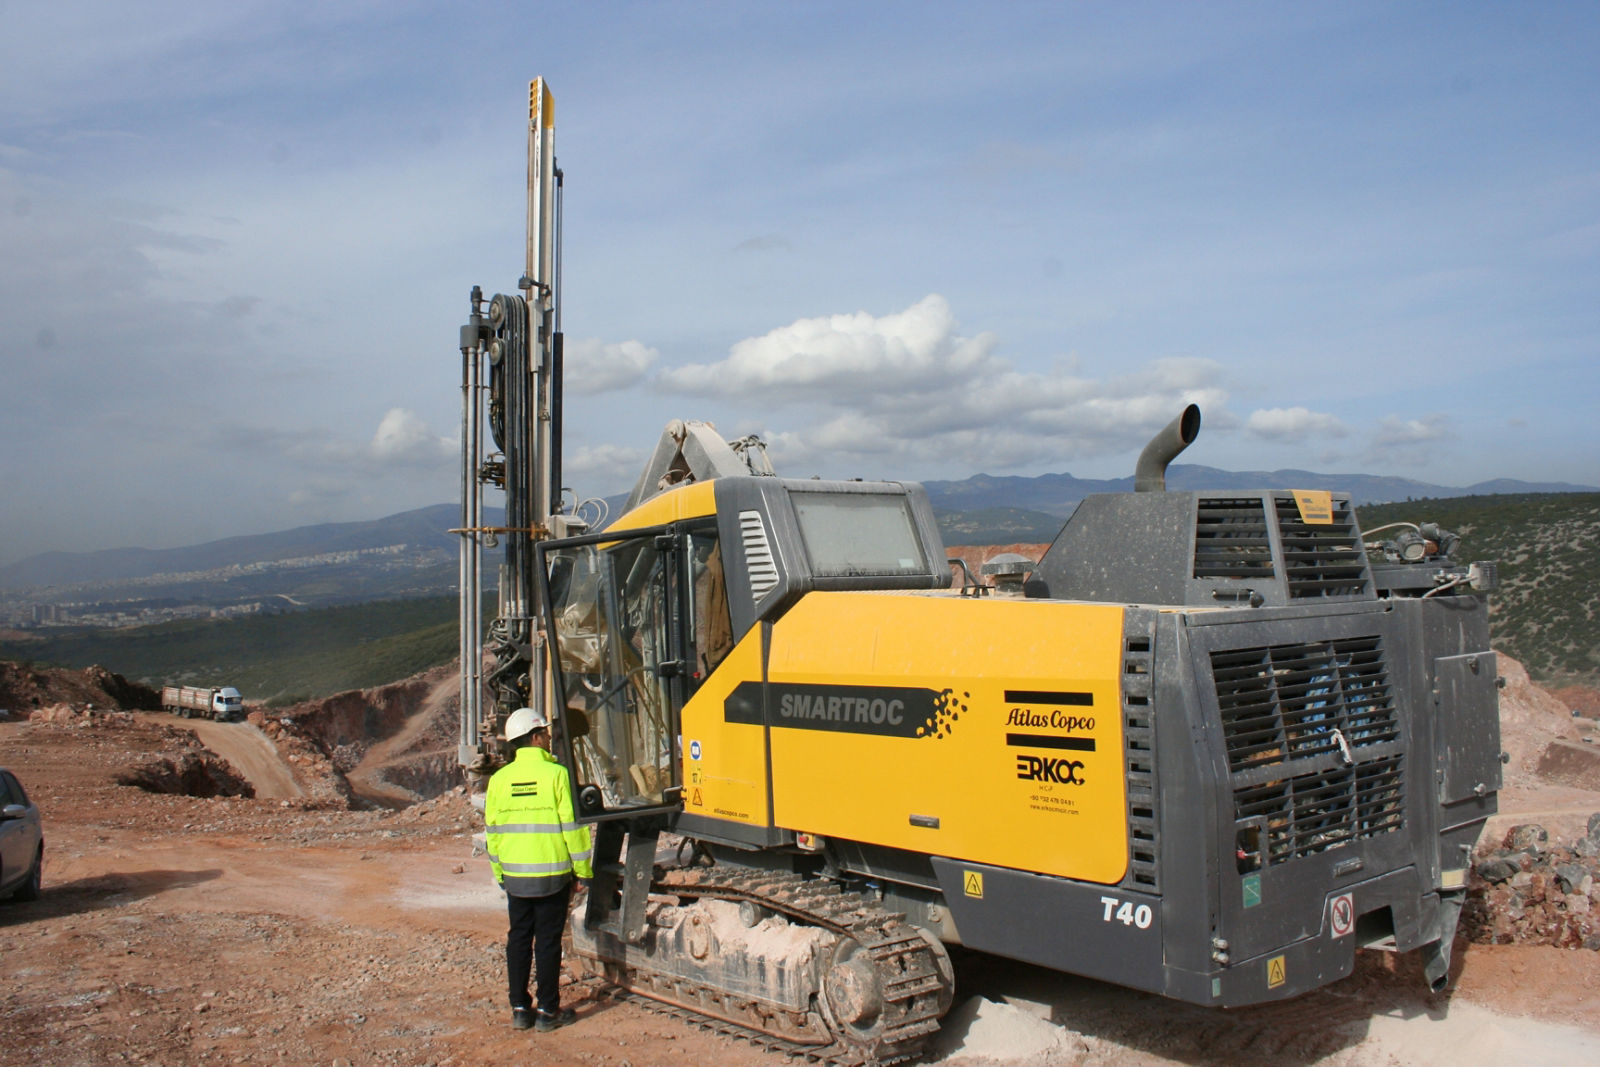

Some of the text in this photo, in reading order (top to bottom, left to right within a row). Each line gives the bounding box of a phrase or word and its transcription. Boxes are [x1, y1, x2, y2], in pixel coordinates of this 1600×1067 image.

[781, 694, 904, 725] SMARTROC
[1005, 708, 1095, 733] Atlas Copco
[1101, 896, 1152, 929] T40
